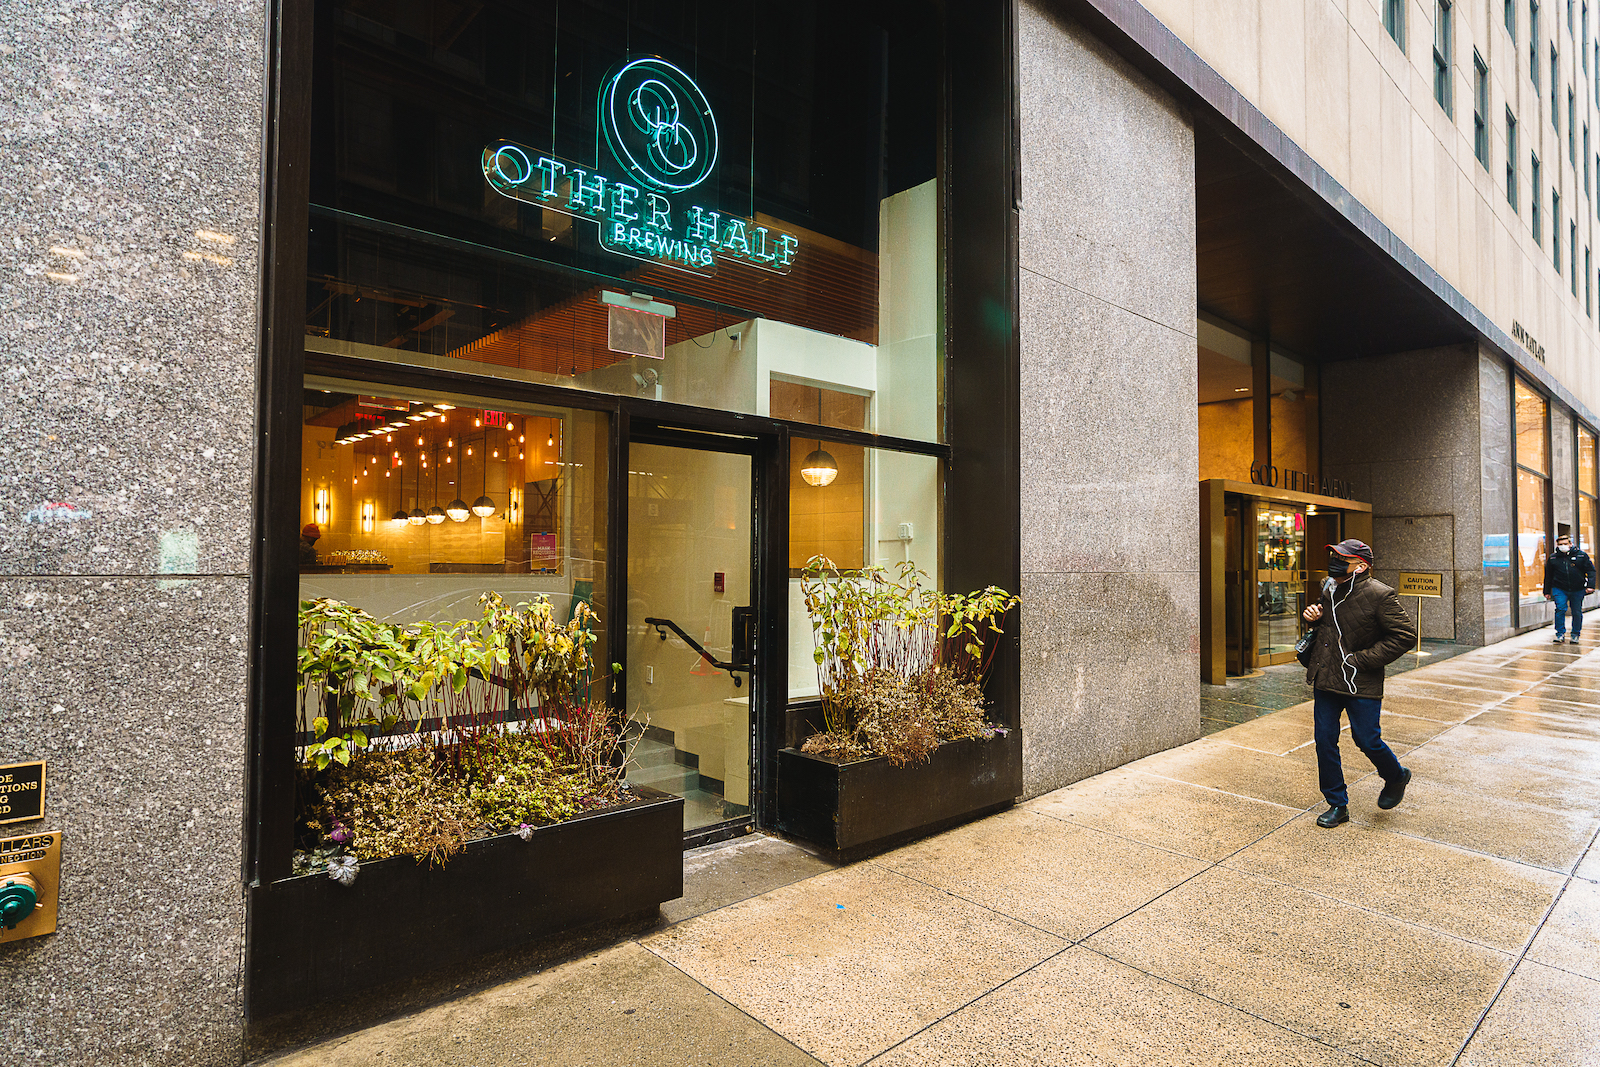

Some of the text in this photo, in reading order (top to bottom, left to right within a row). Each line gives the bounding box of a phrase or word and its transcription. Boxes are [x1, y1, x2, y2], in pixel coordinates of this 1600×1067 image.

[494, 146, 798, 266] OTHER HALF
[614, 222, 713, 267] BREWING
[484, 410, 505, 426] EXIT
[1250, 459, 1278, 488] 600
[1284, 468, 1315, 494] FIFTH
[0, 781, 38, 793] TIONS
